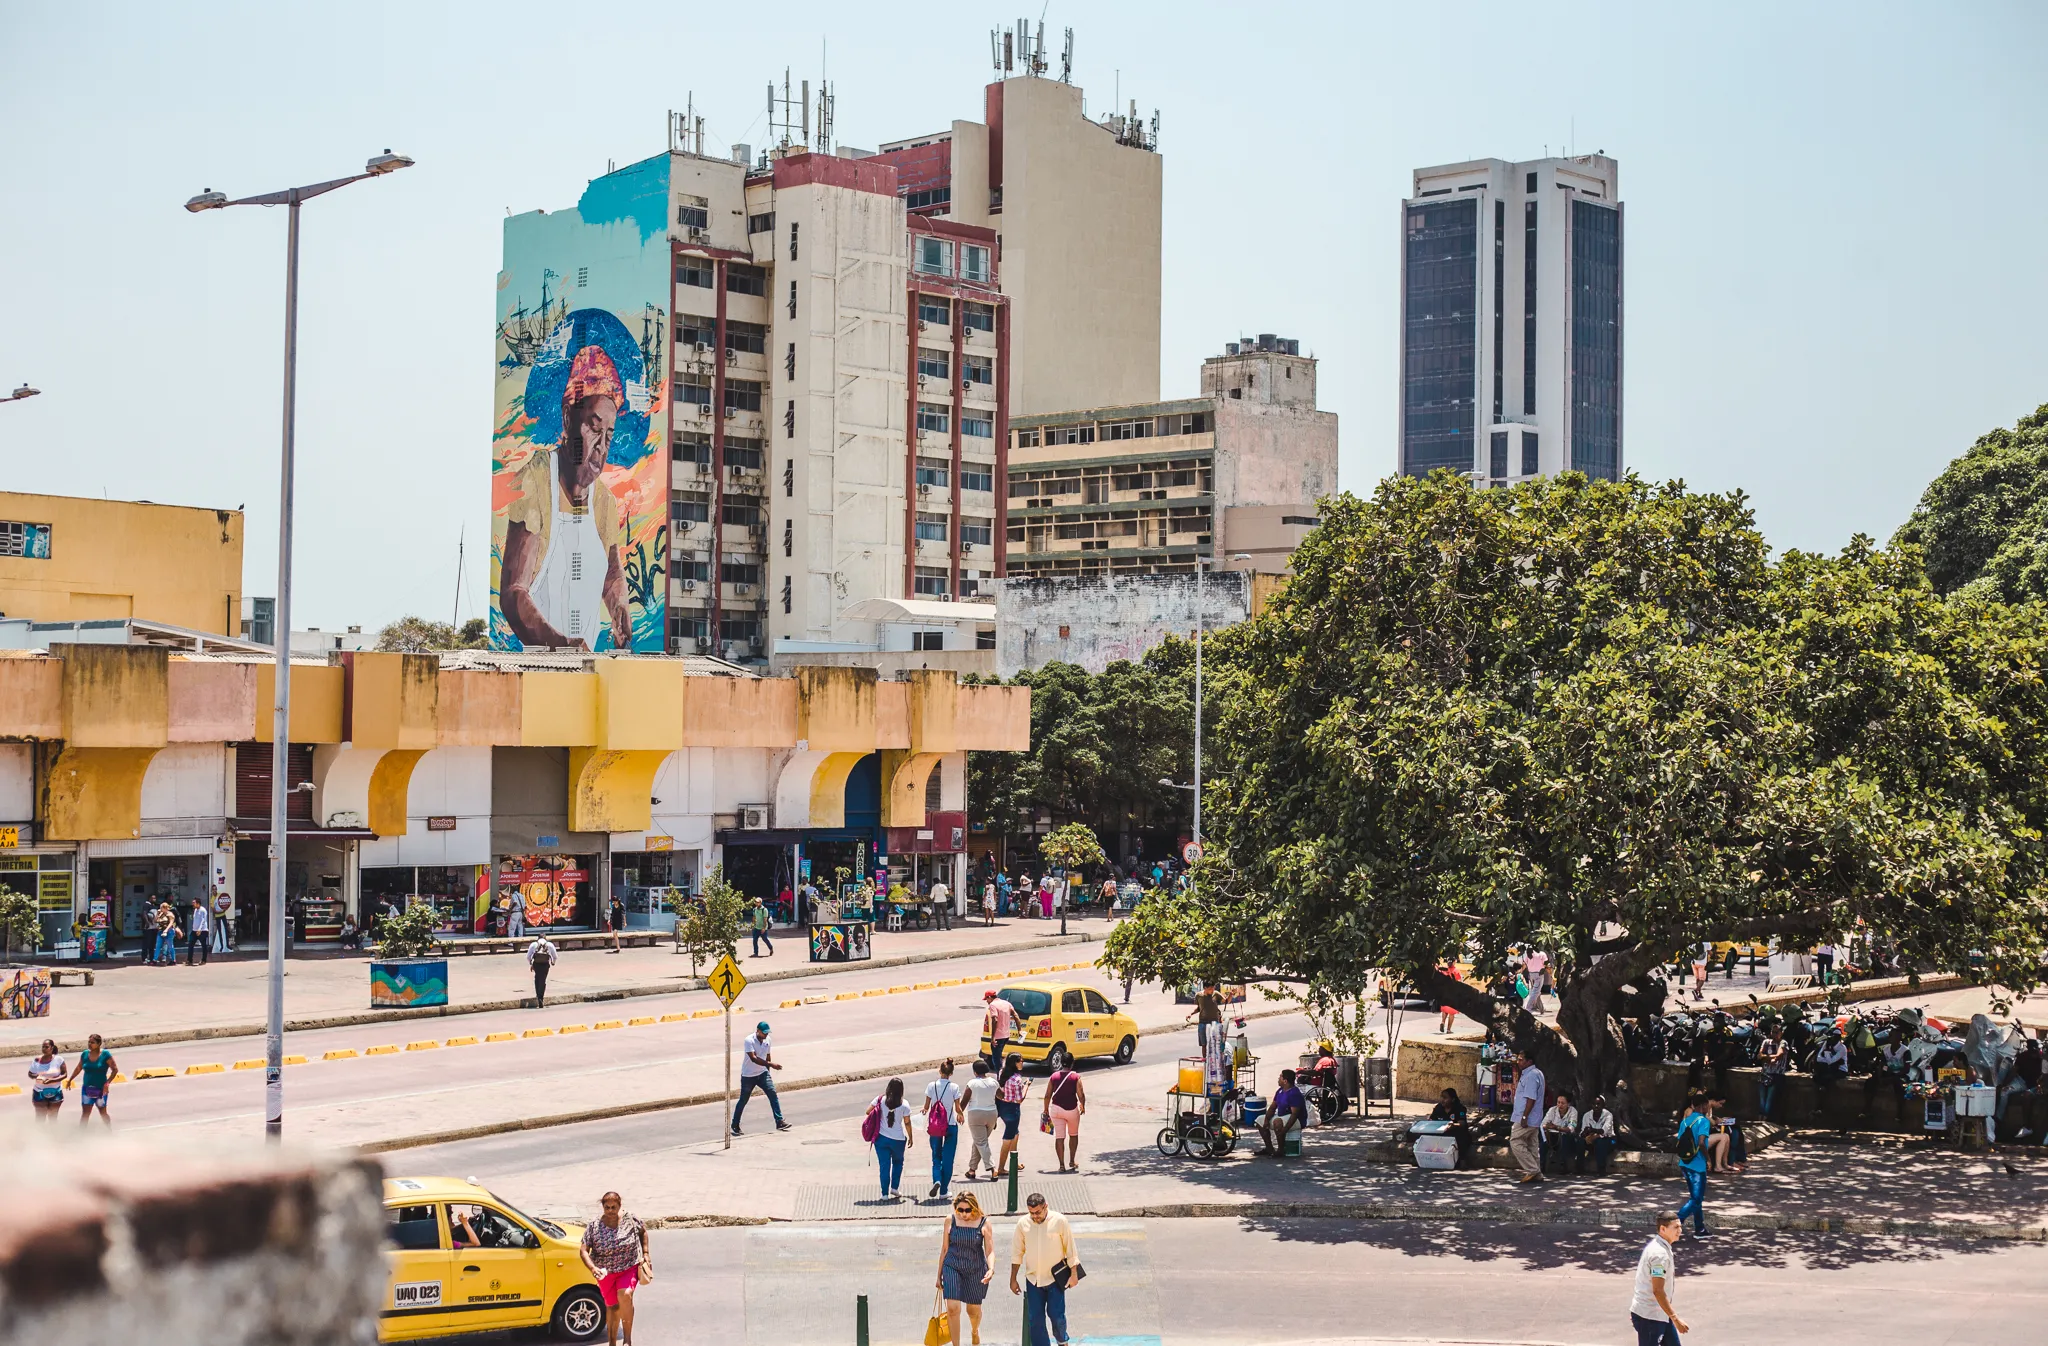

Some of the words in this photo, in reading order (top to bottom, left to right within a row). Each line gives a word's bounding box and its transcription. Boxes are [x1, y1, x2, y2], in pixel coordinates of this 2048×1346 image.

[1188, 848, 1198, 858] 30
[396, 1286, 418, 1301] UAQ
[419, 1285, 440, 1299] 023
[468, 1295, 495, 1303] SERVICIO
